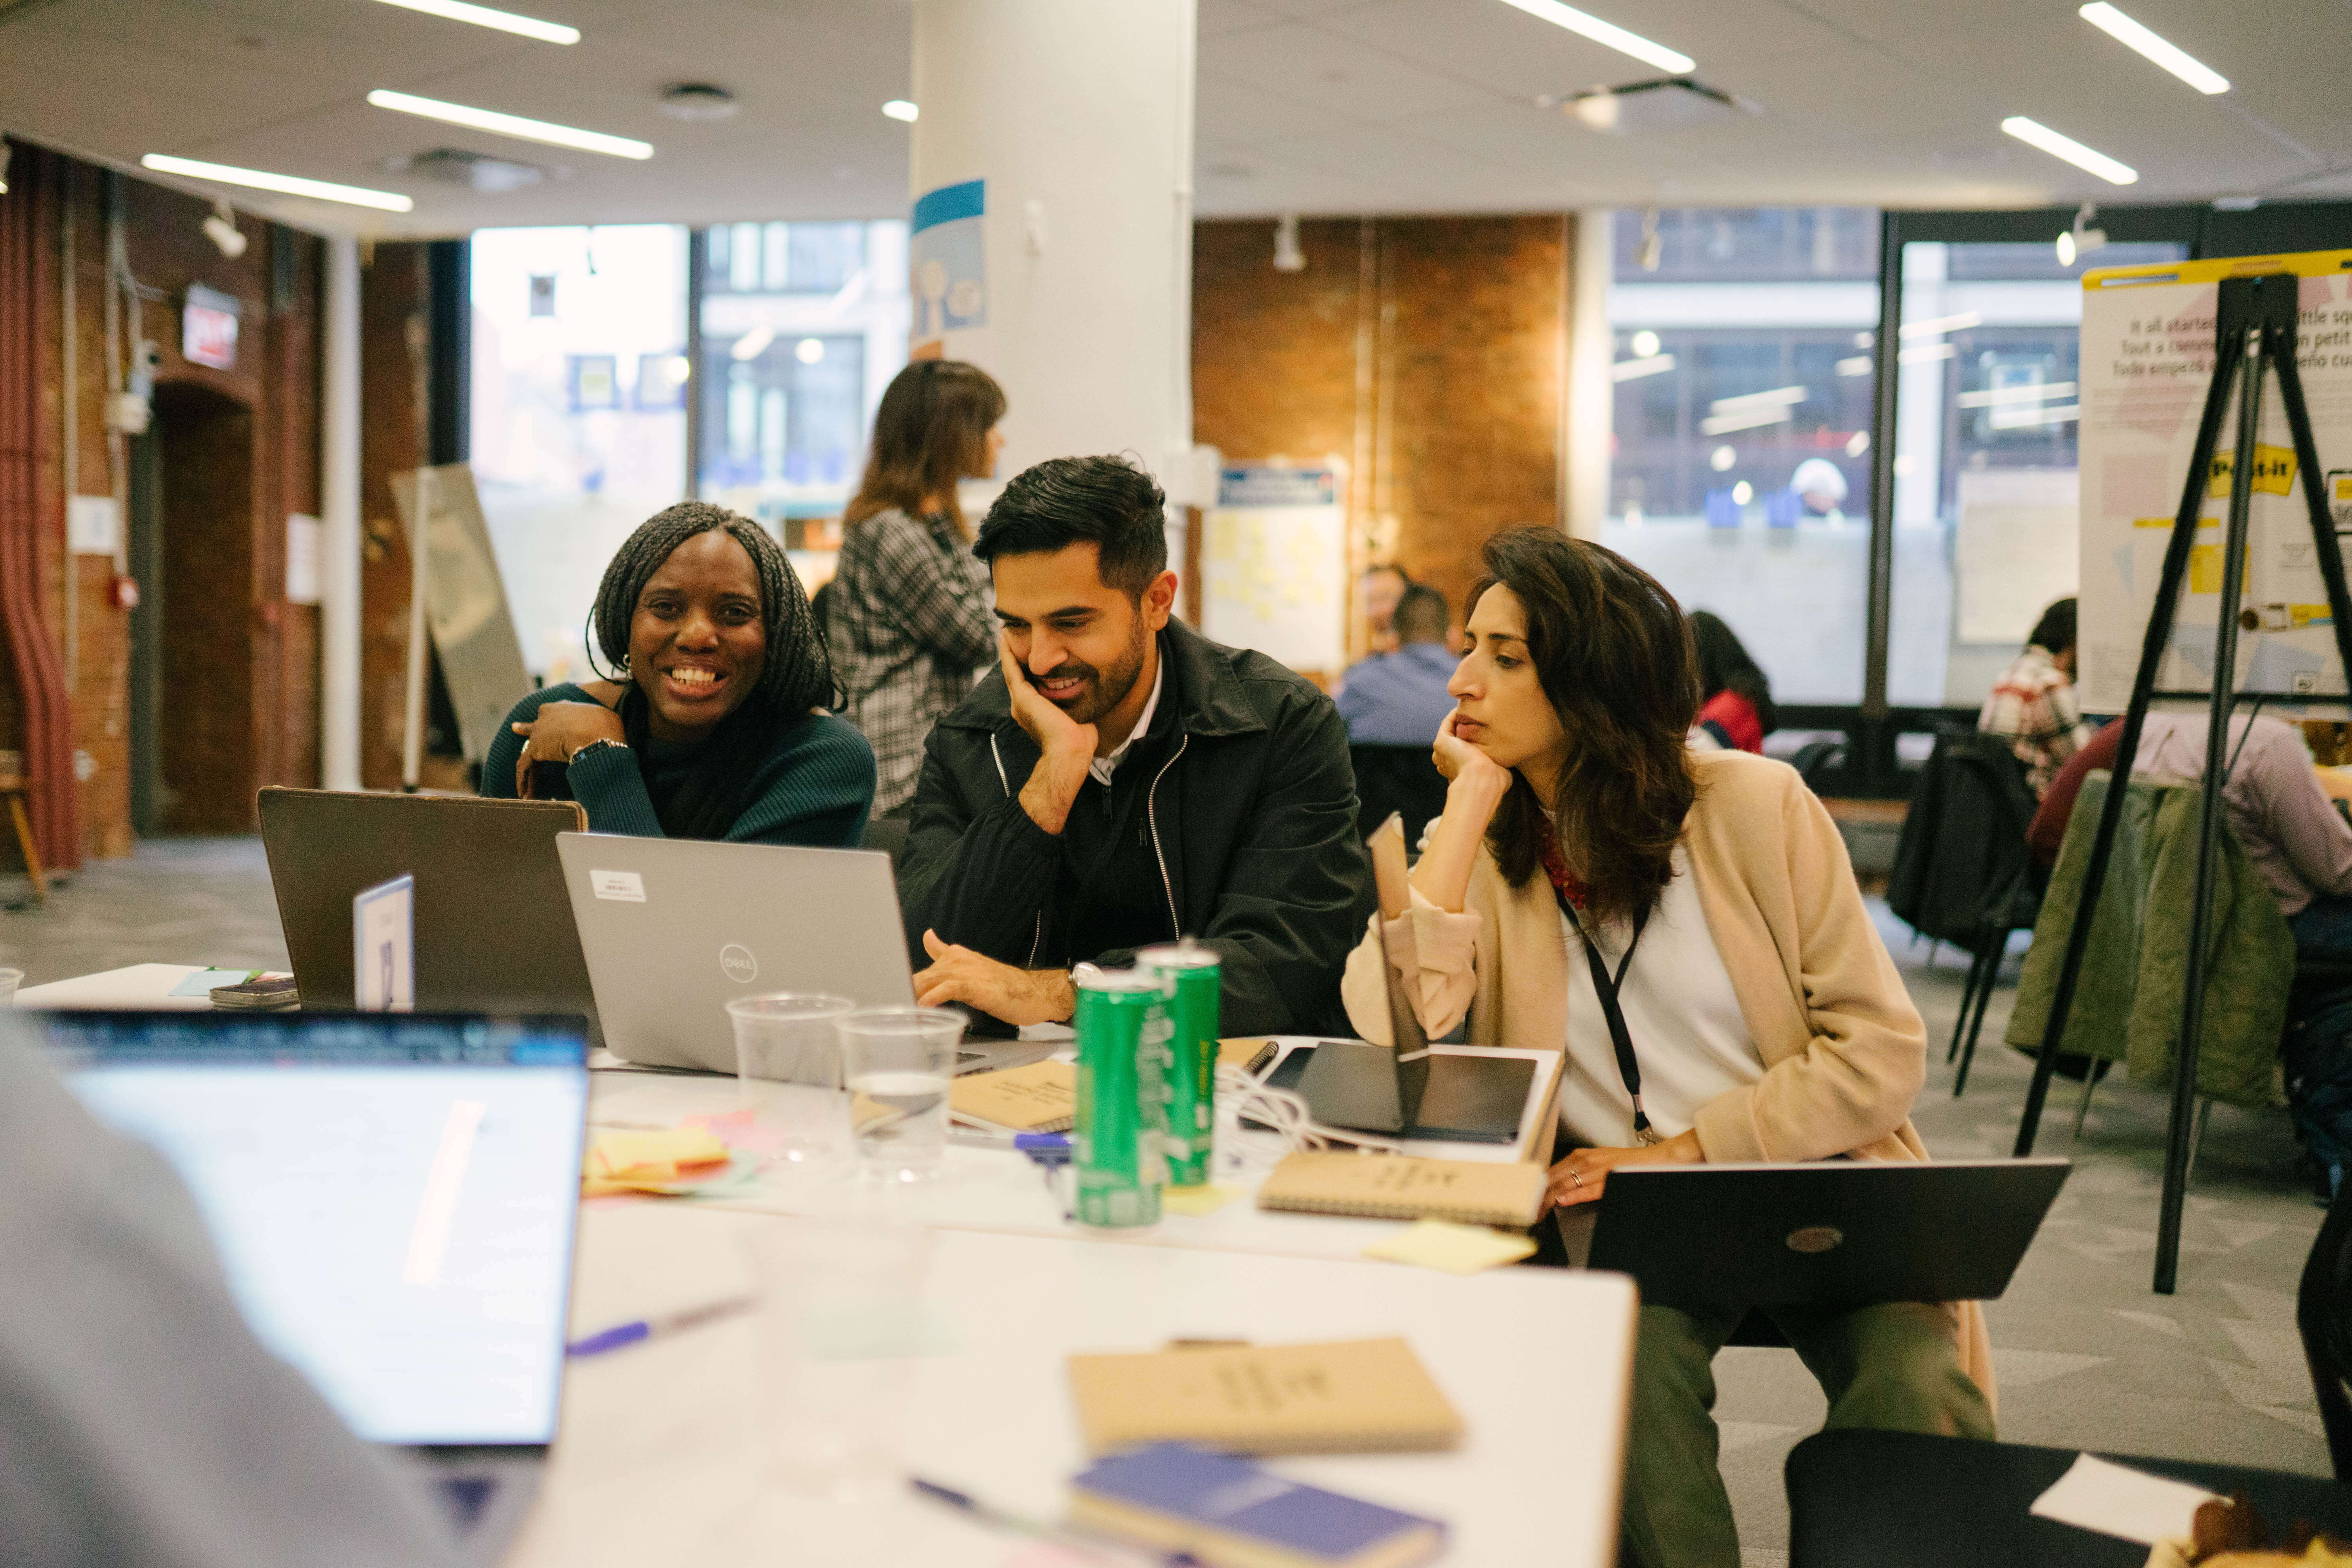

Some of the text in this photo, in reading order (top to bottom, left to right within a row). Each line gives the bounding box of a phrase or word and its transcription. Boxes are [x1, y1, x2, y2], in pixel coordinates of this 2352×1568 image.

[2146, 316, 2161, 333] all
[2156, 342, 2163, 353] a
[2315, 330, 2351, 349] petit
[2213, 458, 2286, 478] Pt-it
[725, 958, 753, 970] DELL
